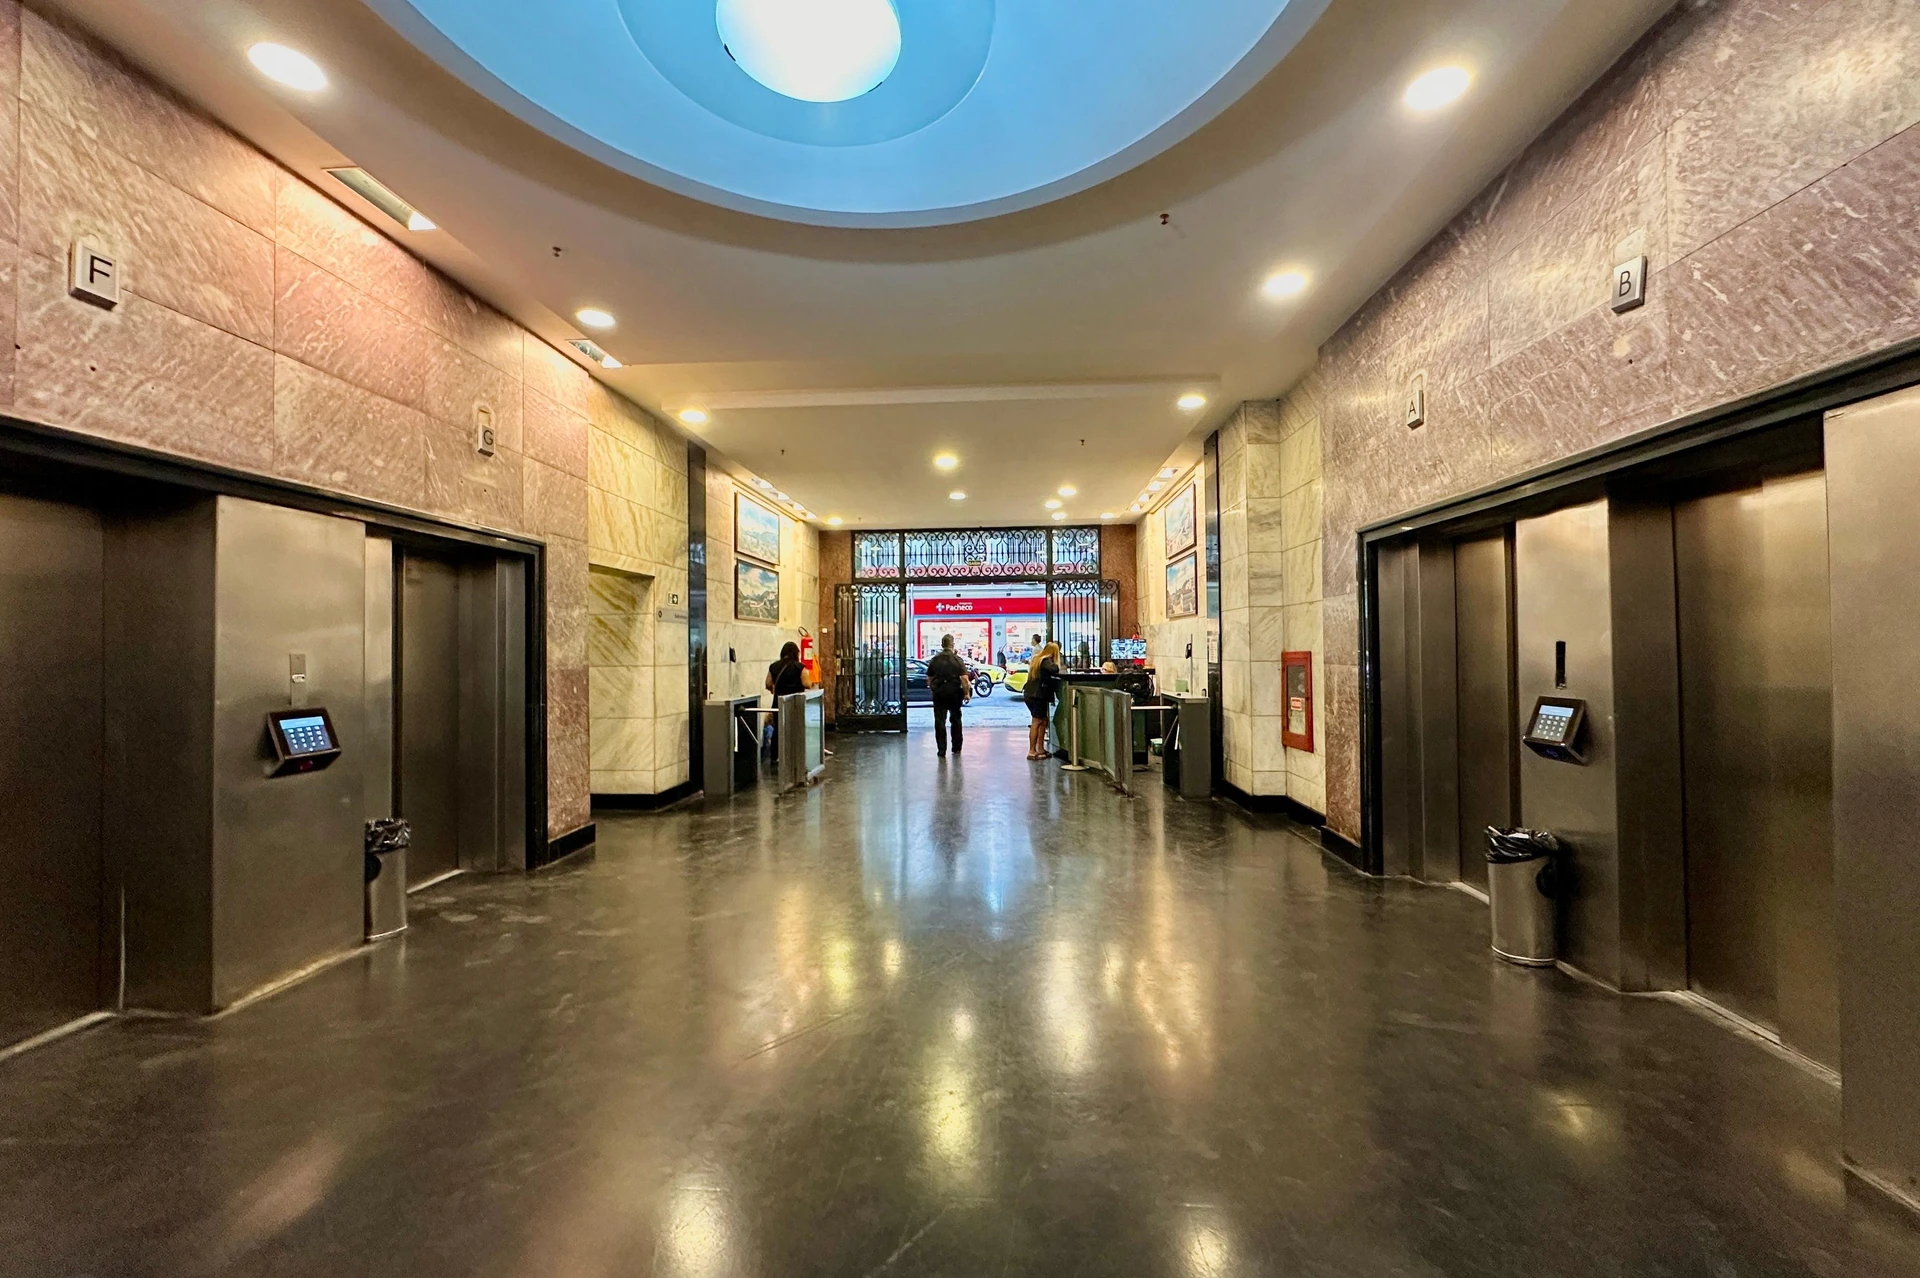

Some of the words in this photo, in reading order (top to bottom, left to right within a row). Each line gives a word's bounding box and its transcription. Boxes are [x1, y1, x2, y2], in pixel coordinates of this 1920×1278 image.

[89, 254, 113, 283] F
[1618, 270, 1632, 298] B
[1408, 400, 1416, 417] A
[483, 429, 493, 445] G
